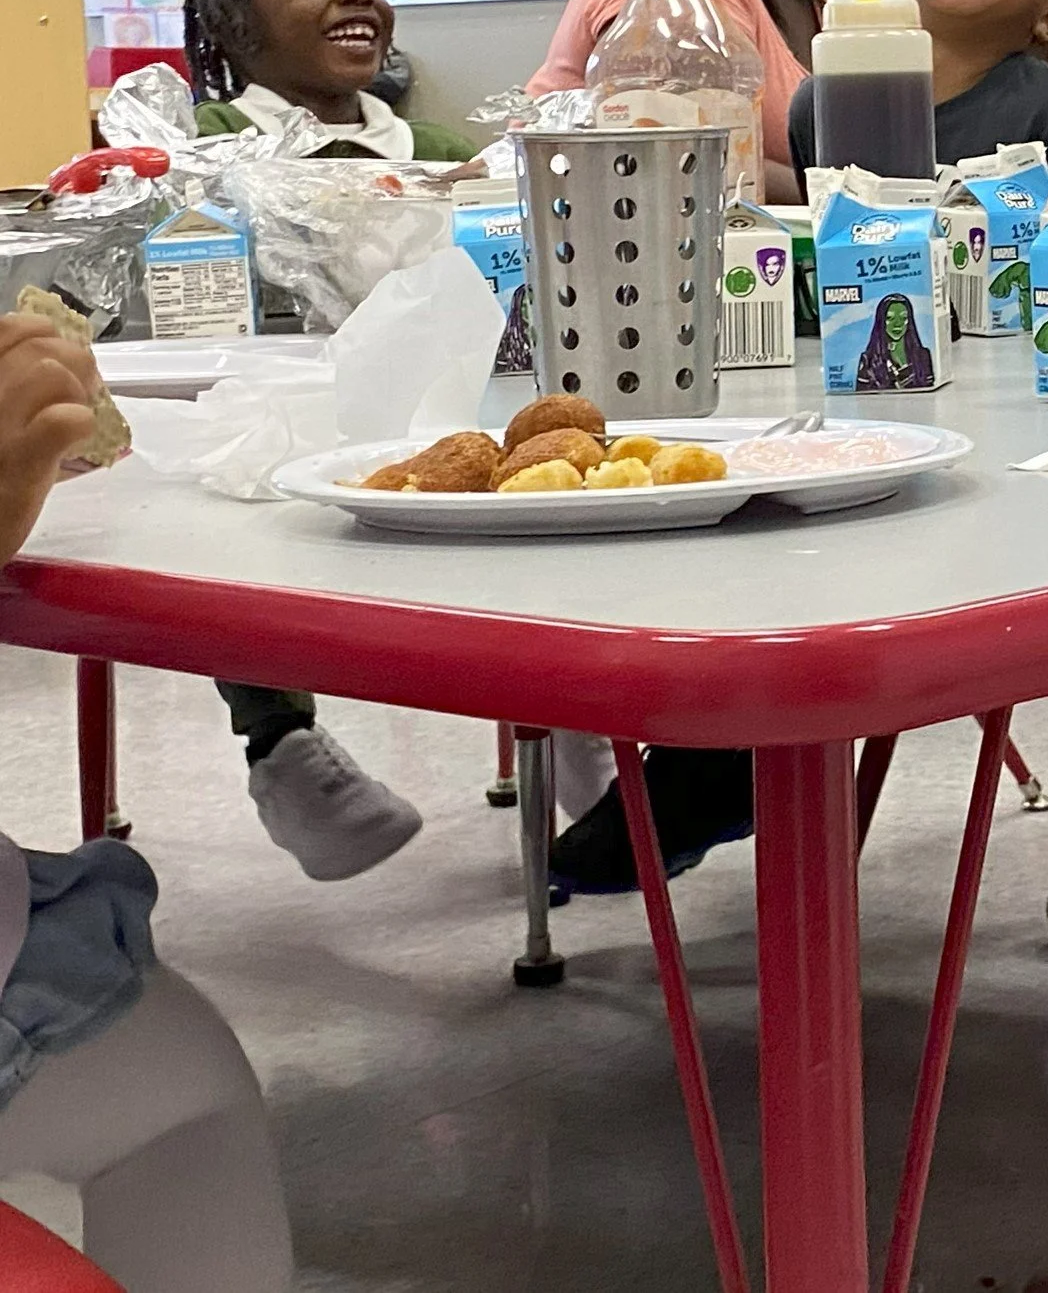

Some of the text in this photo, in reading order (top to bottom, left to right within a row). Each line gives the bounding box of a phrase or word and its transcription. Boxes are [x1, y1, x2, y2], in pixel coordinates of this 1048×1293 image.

[1011, 222, 1033, 240] 1%
[490, 249, 521, 270] 1%
[856, 255, 887, 278] 1%
[888, 252, 921, 264] Lowfat
